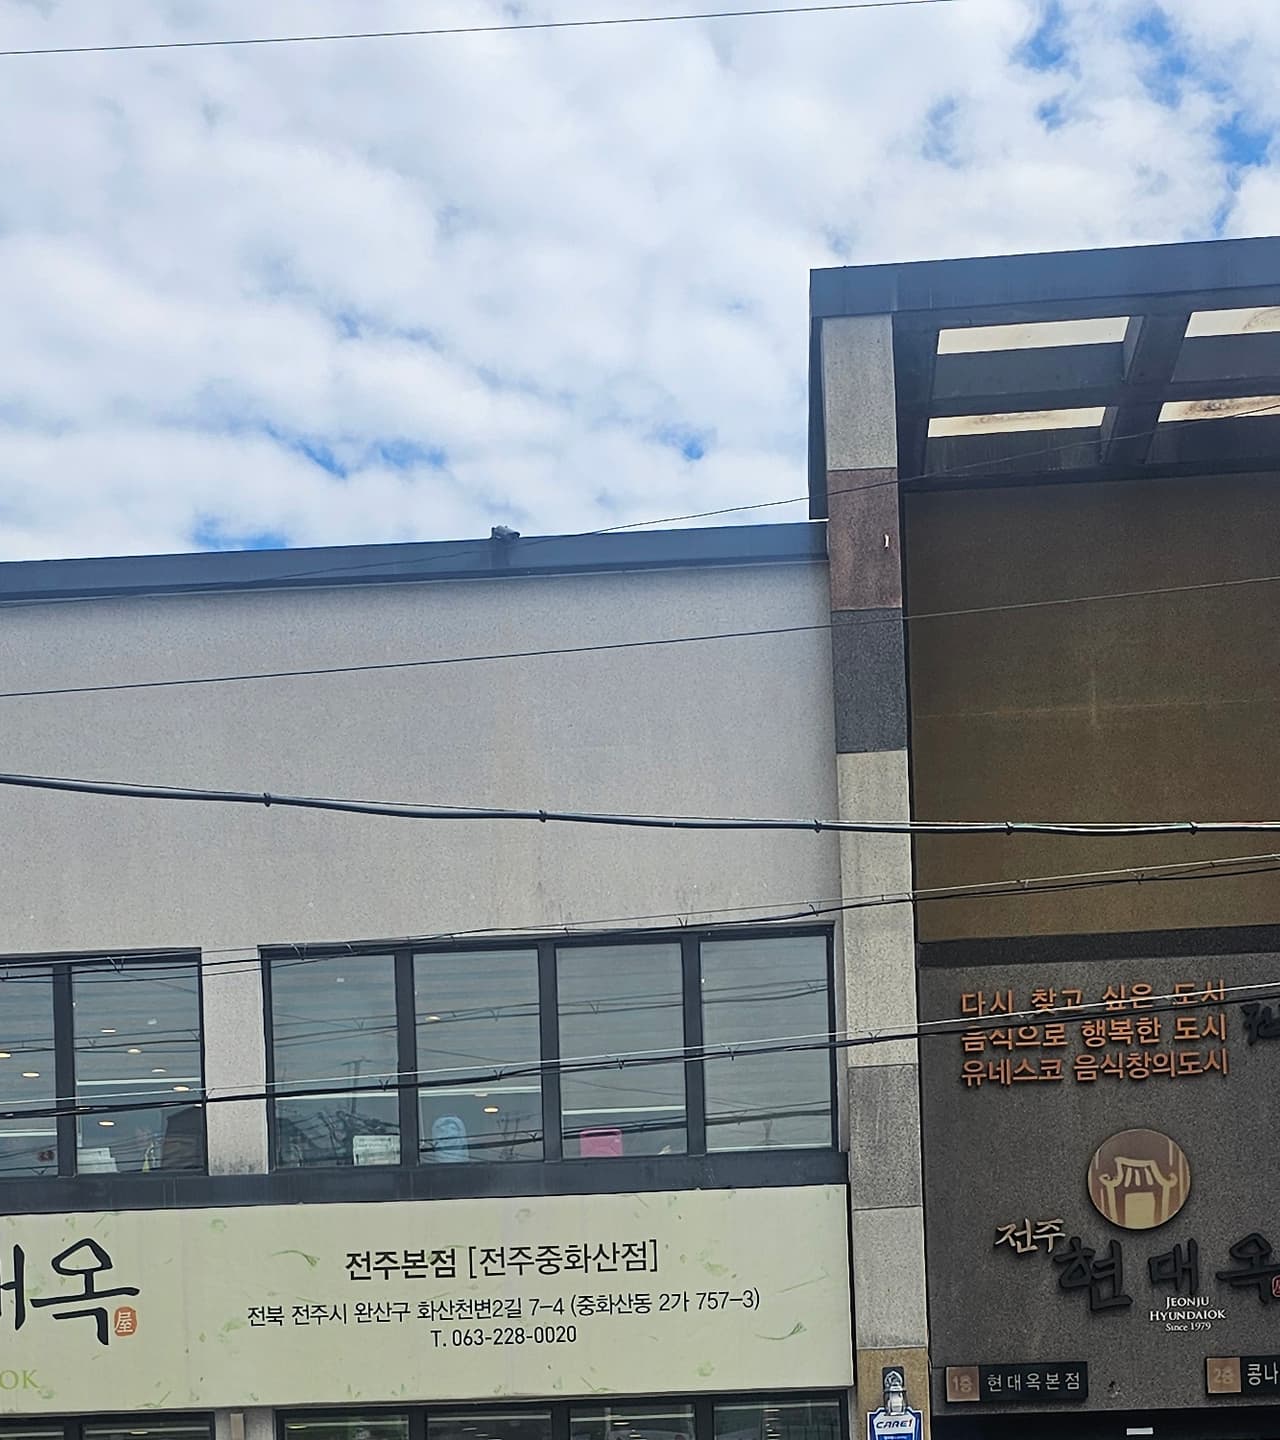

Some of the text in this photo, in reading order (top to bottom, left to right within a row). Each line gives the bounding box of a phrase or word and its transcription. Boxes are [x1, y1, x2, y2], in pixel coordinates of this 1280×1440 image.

[960, 990, 1014, 1017] 다시
[1031, 987, 1084, 1016] 찾고
[1101, 982, 1153, 1012] 싶은
[1081, 1017, 1161, 1047] 행복한
[1174, 1013, 1227, 1042] 도시
[961, 1048, 1230, 1087] 유네스코 음식창의도시
[995, 1217, 1067, 1254] 전주
[344, 1236, 660, 1283] 전주본점 [전주중화산점]
[247, 1286, 761, 1329] 전북 전주시 완산구 화산천변2길 7-4 (중화산동 2가 757-3)
[1149, 1308, 1227, 1322] HYUNDAIOK
[1164, 1296, 1210, 1309] JEONJU
[431, 1324, 578, 1348] T. 063-228-0020
[1165, 1321, 1212, 1333] Since 1979
[986, 1371, 1081, 1394] 현대옥본점
